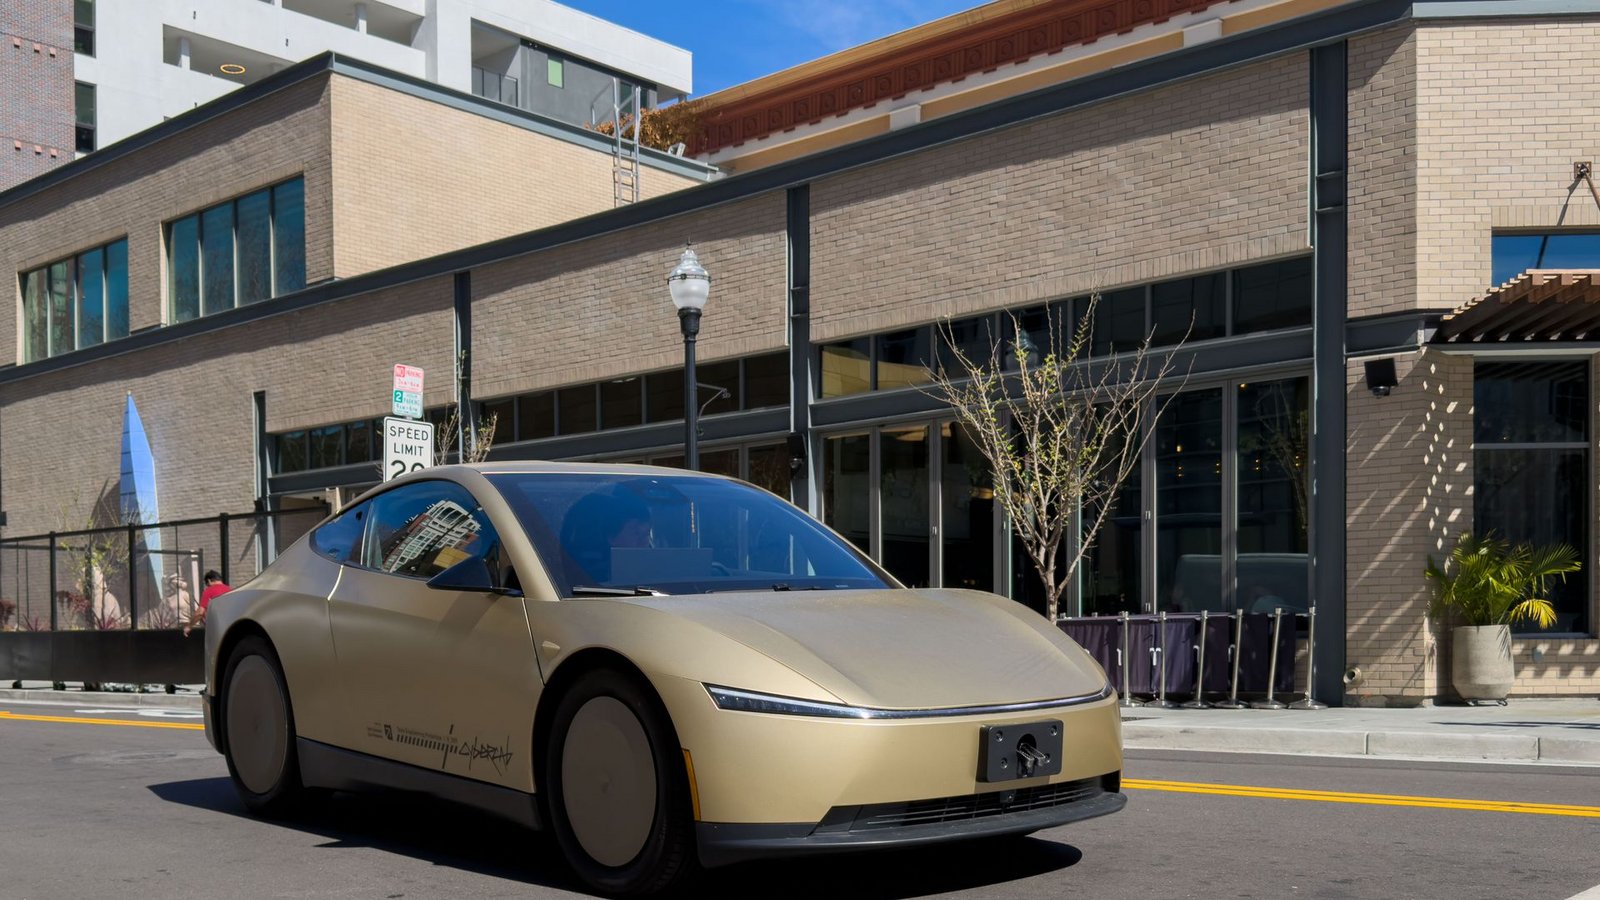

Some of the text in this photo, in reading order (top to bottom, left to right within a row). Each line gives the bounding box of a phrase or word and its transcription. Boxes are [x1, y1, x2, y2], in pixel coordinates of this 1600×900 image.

[395, 391, 402, 402] 2
[390, 426, 429, 441] SPEED
[394, 442, 424, 456] LIMIT
